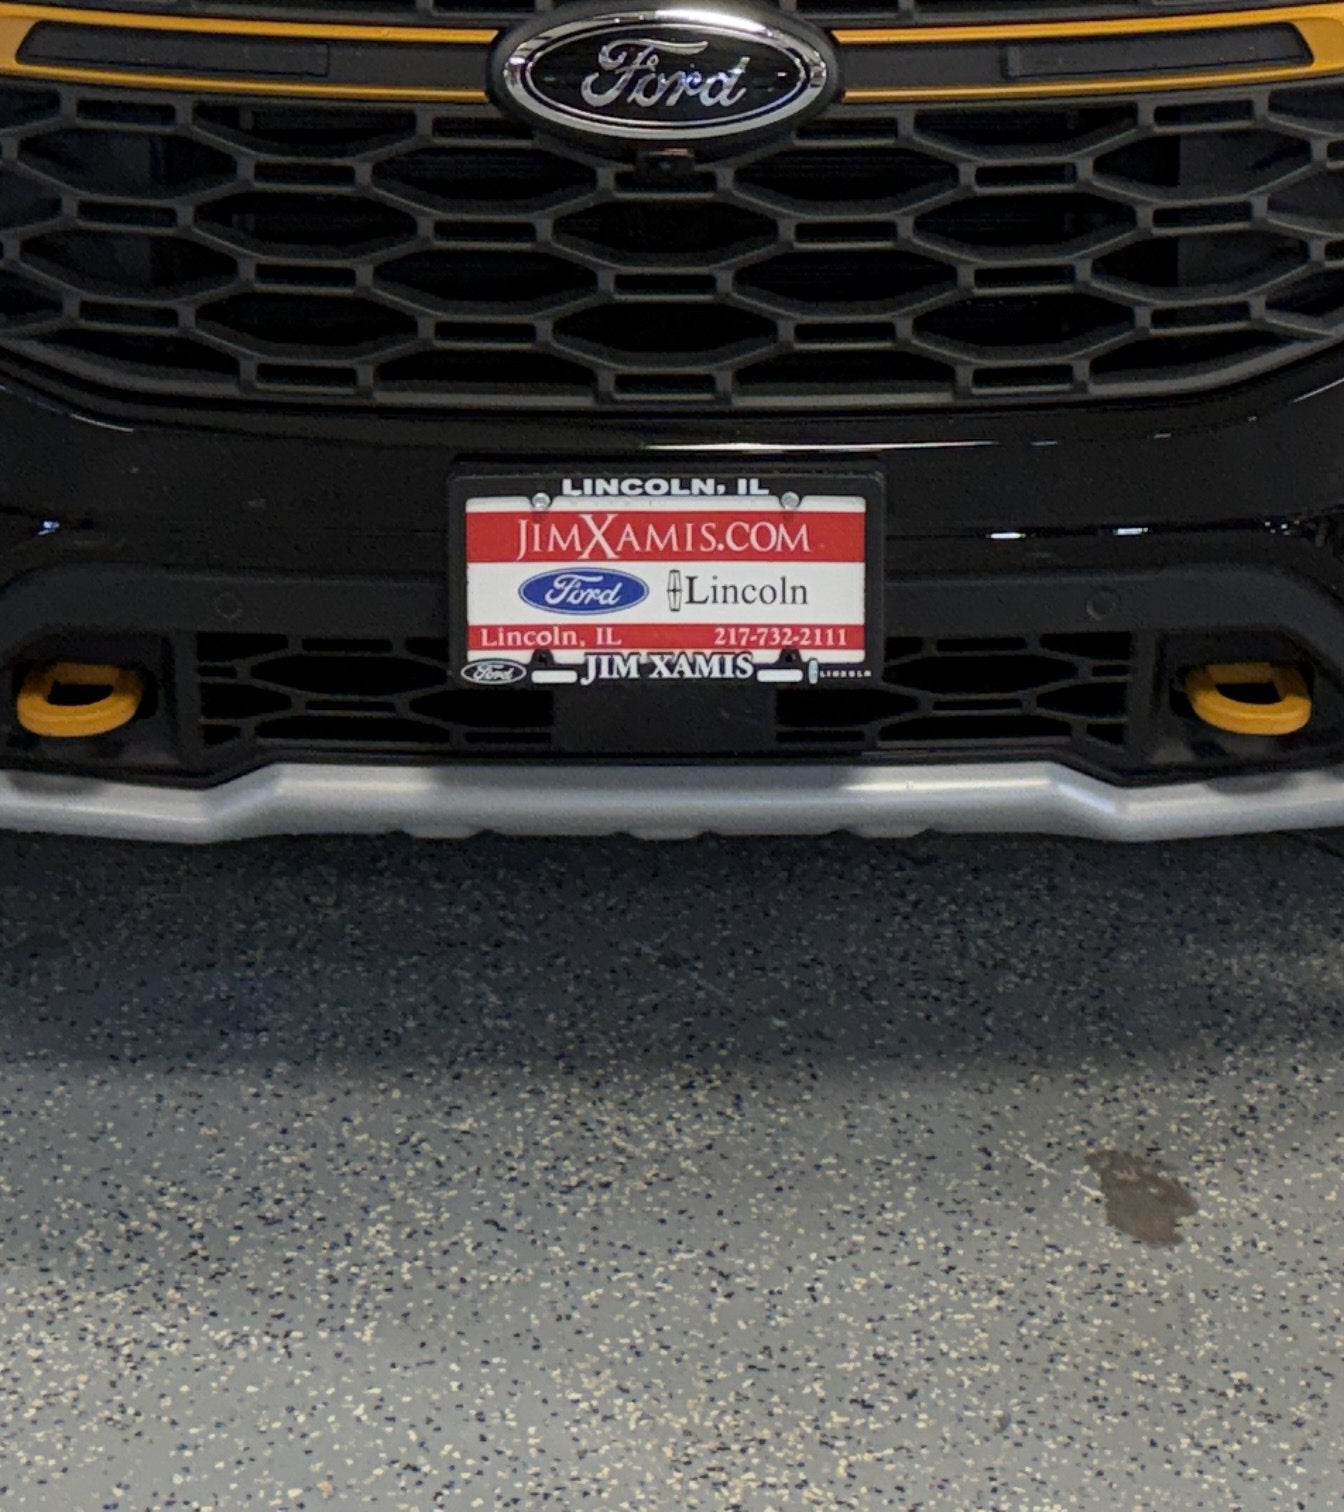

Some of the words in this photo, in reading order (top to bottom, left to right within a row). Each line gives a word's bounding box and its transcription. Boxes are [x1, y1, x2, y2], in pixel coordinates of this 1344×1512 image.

[581, 38, 750, 108] Ford
[562, 478, 725, 496] LINCOLN,
[737, 478, 769, 495] IL
[516, 513, 811, 561] JIMXAMIS.COM
[544, 573, 622, 606] Ford
[685, 576, 808, 605] Lincoln
[480, 626, 586, 648] Lincoln,
[595, 627, 622, 646] IL
[714, 627, 847, 647] 217-732-2111
[580, 653, 639, 685] JIM
[649, 652, 754, 679] XAMIS
